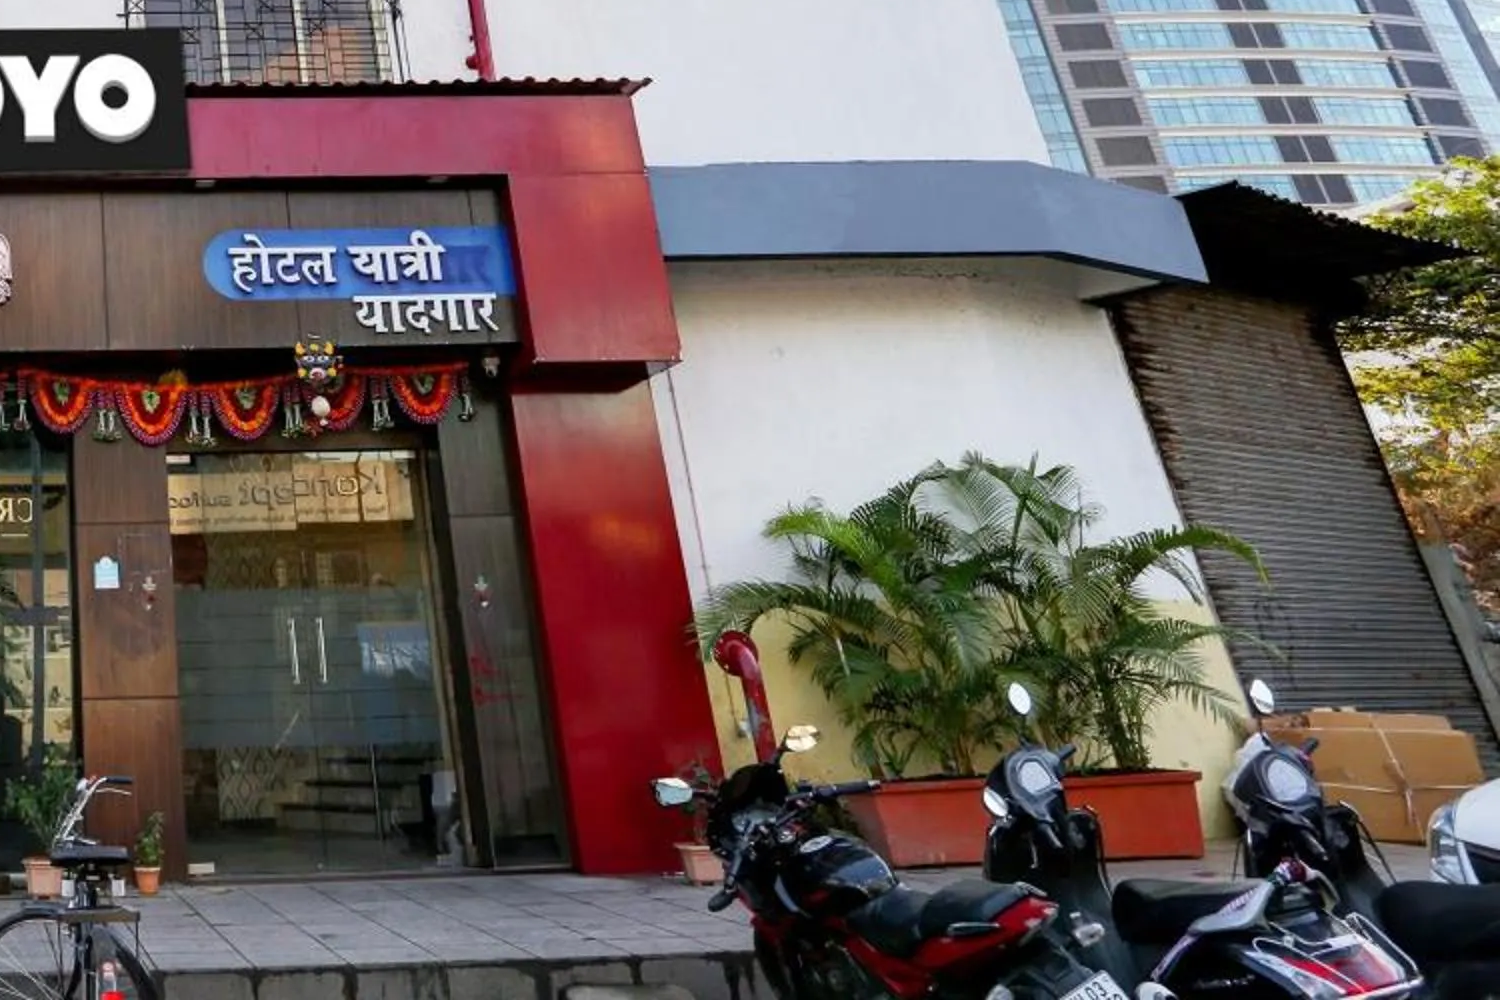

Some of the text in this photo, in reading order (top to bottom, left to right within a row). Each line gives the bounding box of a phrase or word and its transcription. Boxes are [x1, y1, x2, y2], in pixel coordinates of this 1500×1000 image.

[227, 229, 446, 292] होटल यात्री
[352, 291, 499, 334] यादगार
